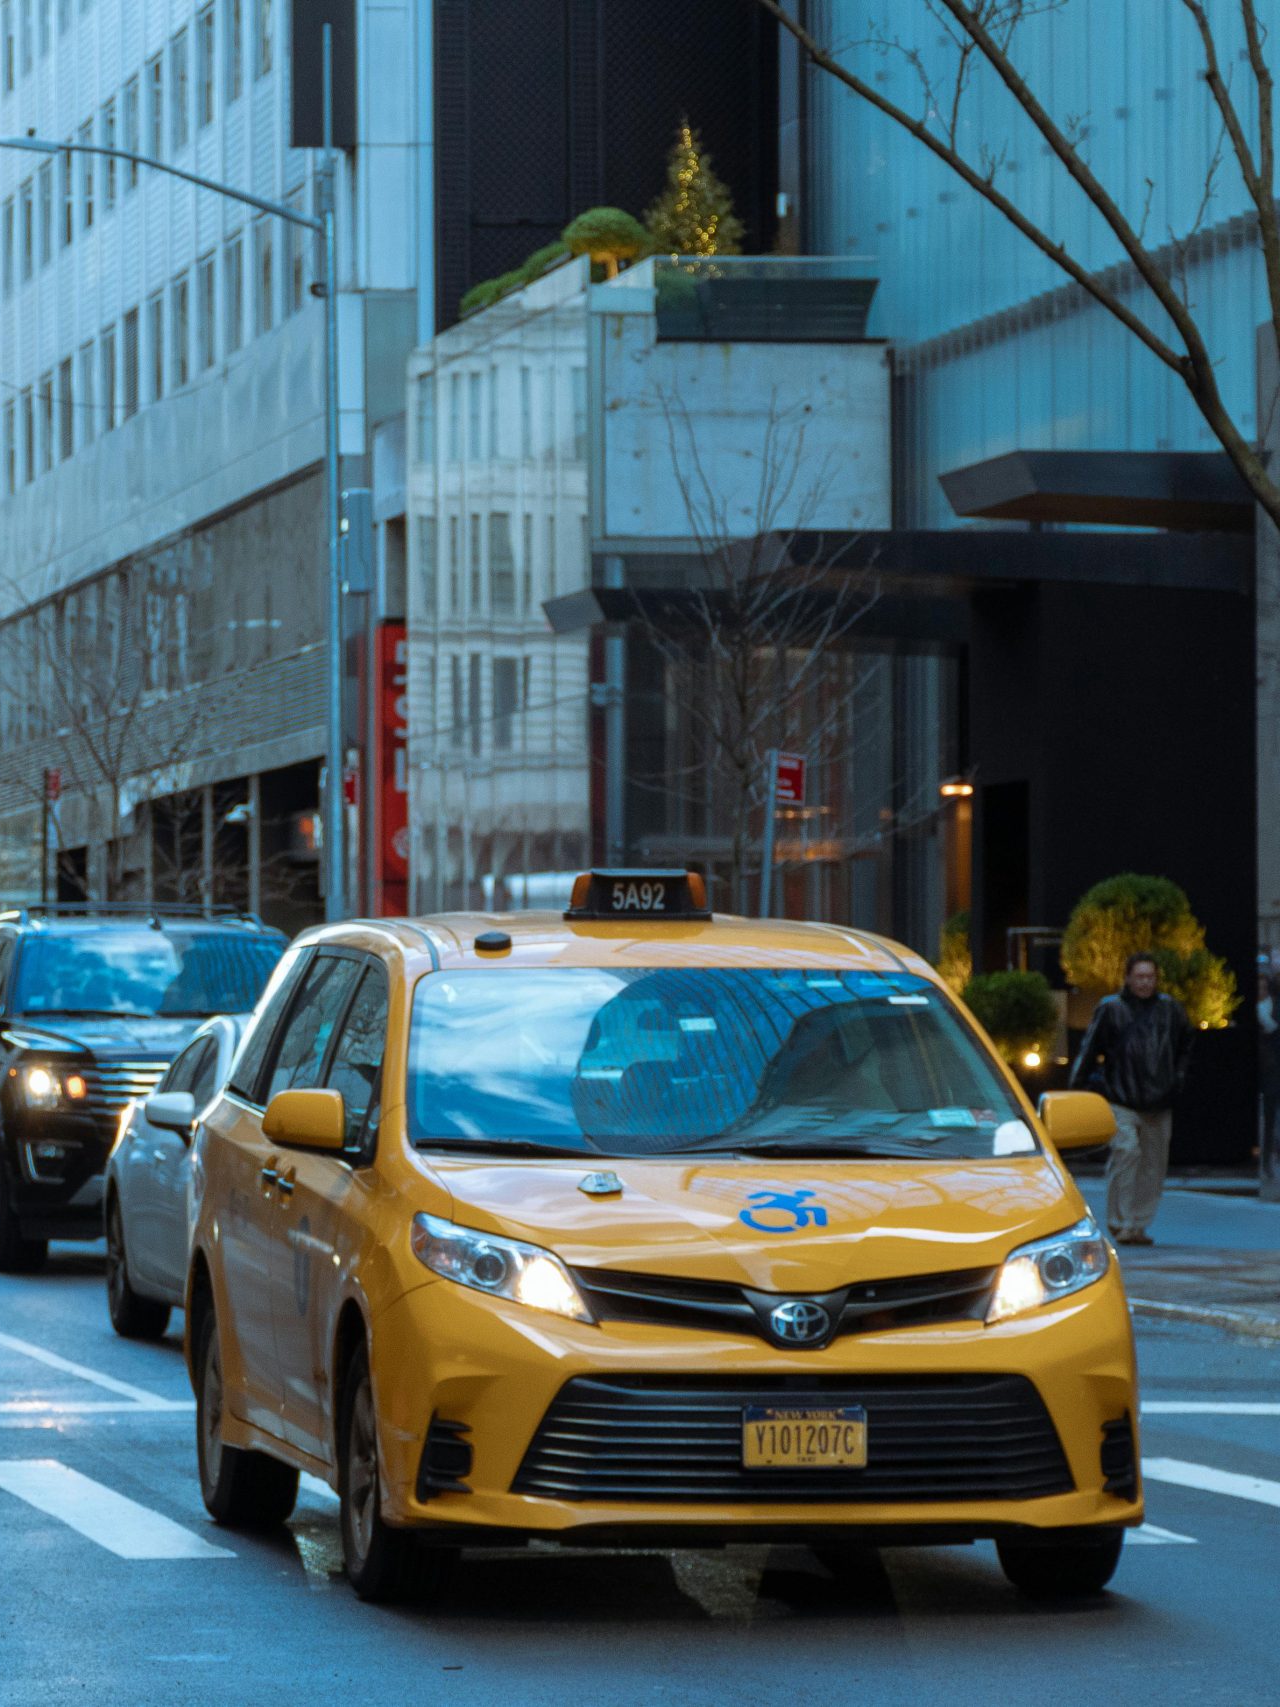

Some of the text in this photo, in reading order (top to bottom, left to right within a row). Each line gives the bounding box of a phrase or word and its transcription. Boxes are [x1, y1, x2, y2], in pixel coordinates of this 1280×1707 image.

[612, 882, 665, 910] 5A92
[775, 1410, 837, 1421] NEW YORK
[756, 1425, 855, 1456] Y101207C
